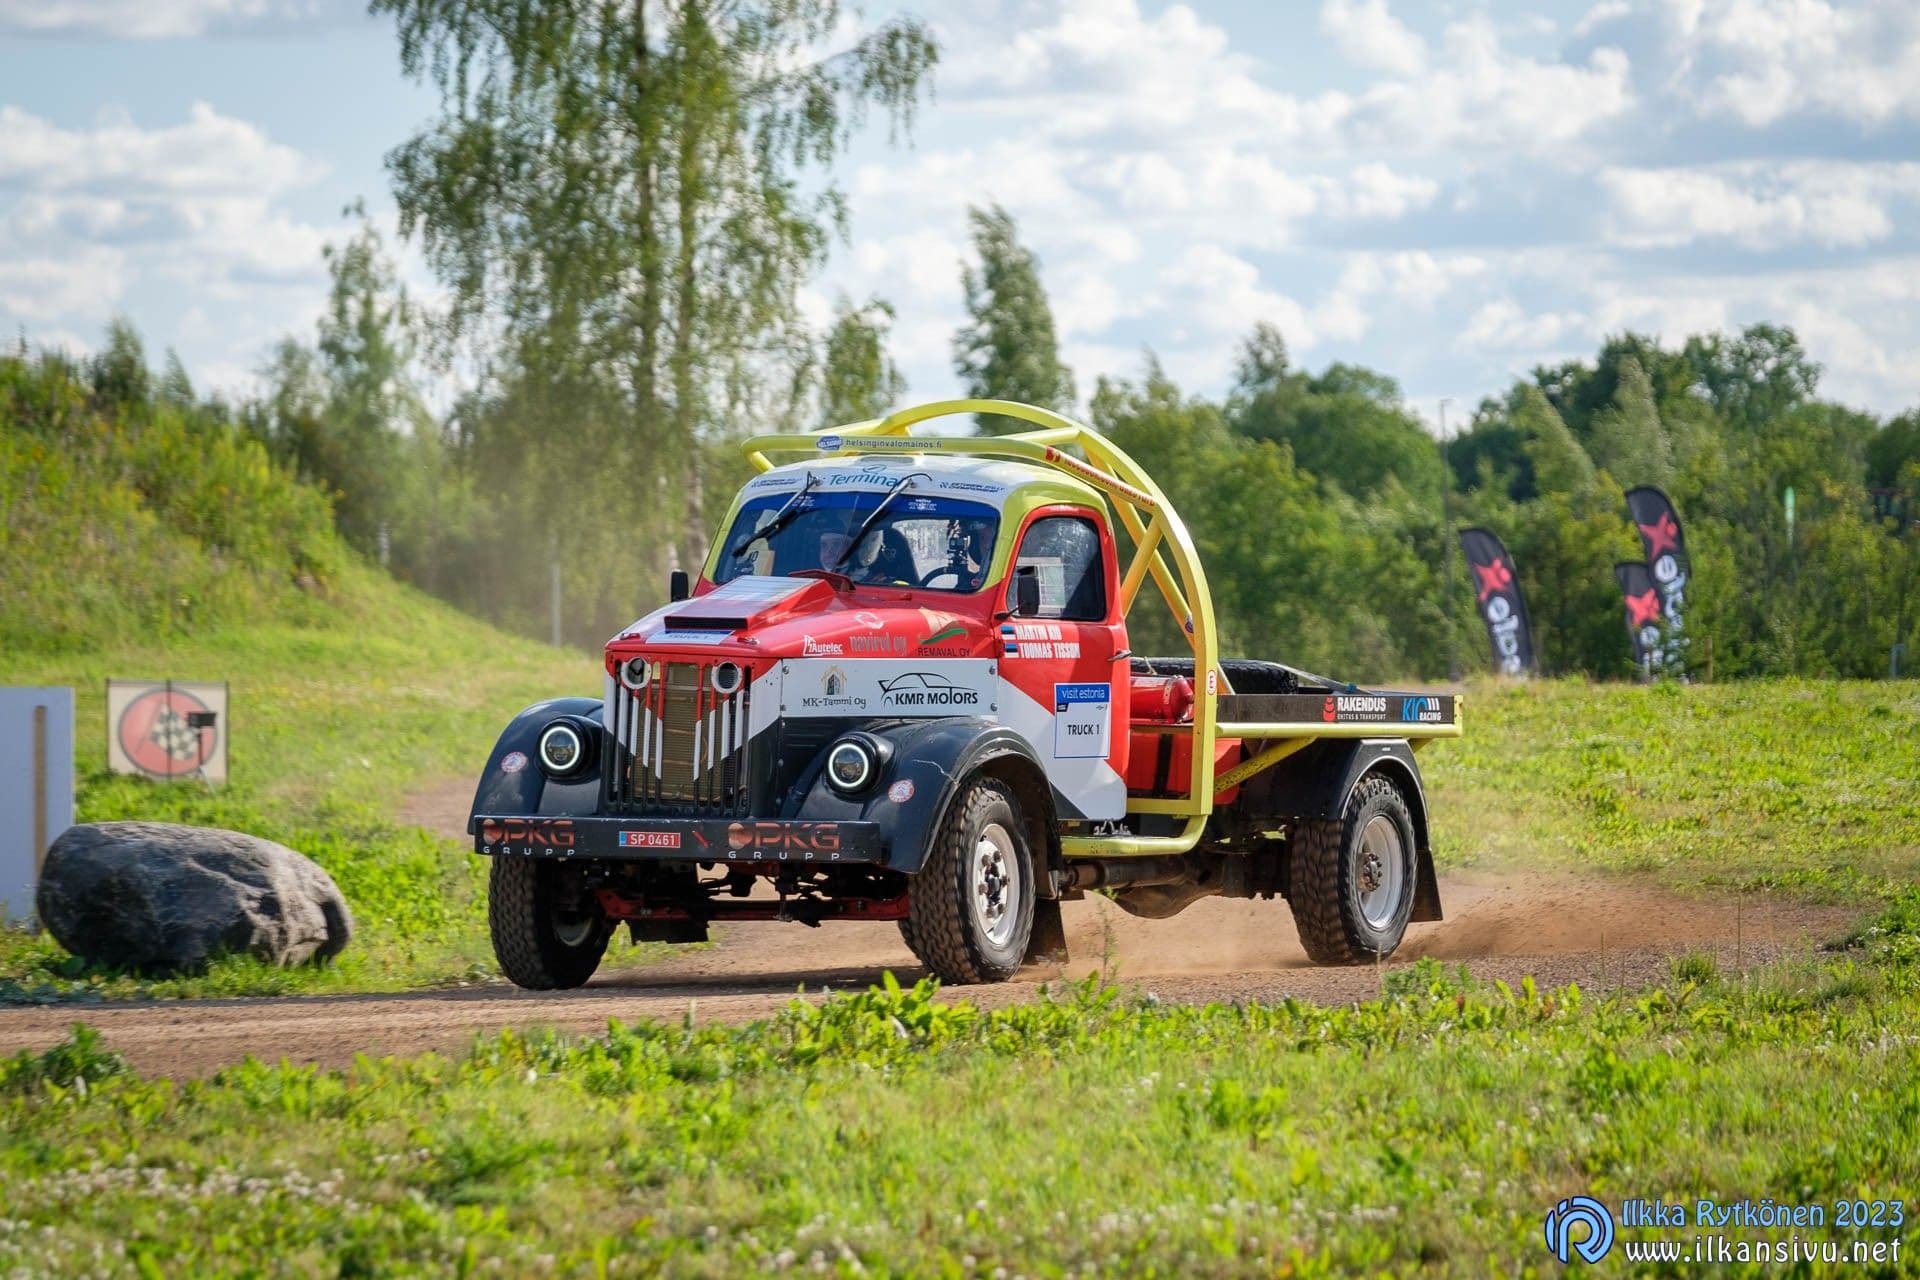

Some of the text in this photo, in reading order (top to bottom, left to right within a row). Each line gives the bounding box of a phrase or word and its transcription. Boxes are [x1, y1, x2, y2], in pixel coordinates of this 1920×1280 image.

[846, 438, 942, 449] helsinginvalomainos.fi
[830, 473, 903, 487] Termina
[1015, 624, 1048, 640] MARTIN
[917, 647, 957, 657] REMAVAL
[1018, 642, 1053, 659] TOOMAS
[895, 689, 979, 705] KMR MOTORS
[1061, 688, 1105, 699] visit estonia
[802, 697, 867, 709] MK-Tammi Oy
[1337, 697, 1387, 712] RAKENDUS
[1419, 712, 1442, 721] RACING
[1067, 724, 1094, 735] TRUCK
[630, 831, 676, 846] SP 0461
[483, 846, 575, 856] GRUPP
[728, 851, 840, 861] GRUPP
